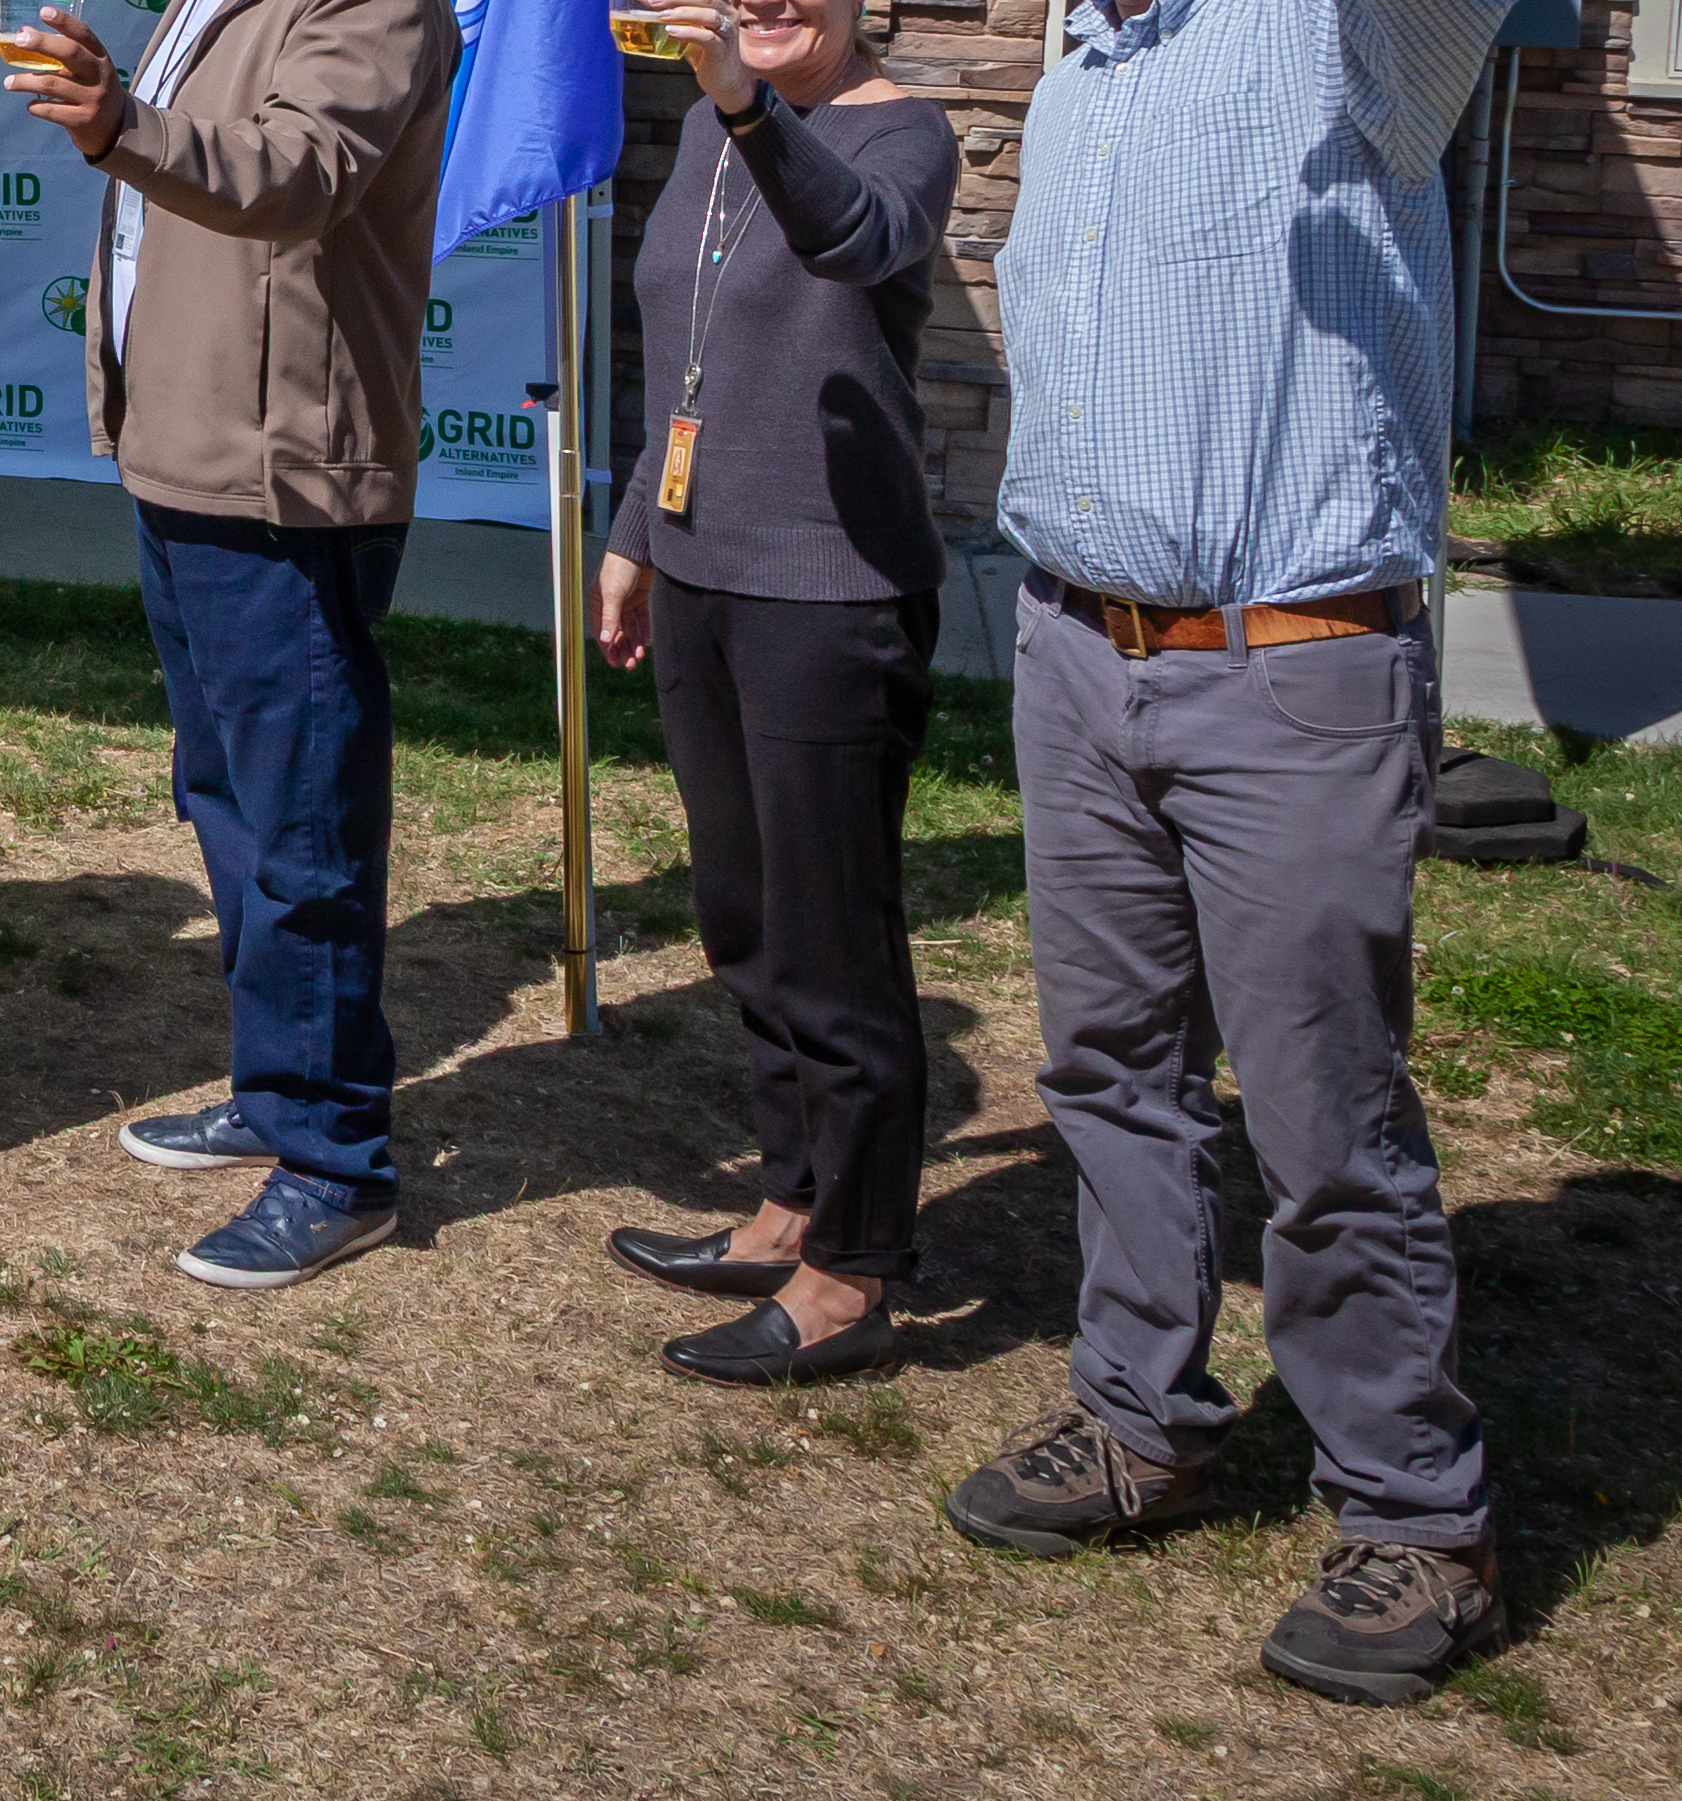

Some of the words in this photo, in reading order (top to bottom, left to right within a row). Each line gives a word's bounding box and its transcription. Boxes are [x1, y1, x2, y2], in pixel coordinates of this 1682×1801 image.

[437, 408, 535, 450] GRID
[439, 449, 537, 465] ALTERNATIVES
[454, 467, 485, 478] Inland
[486, 468, 519, 480] Empire
